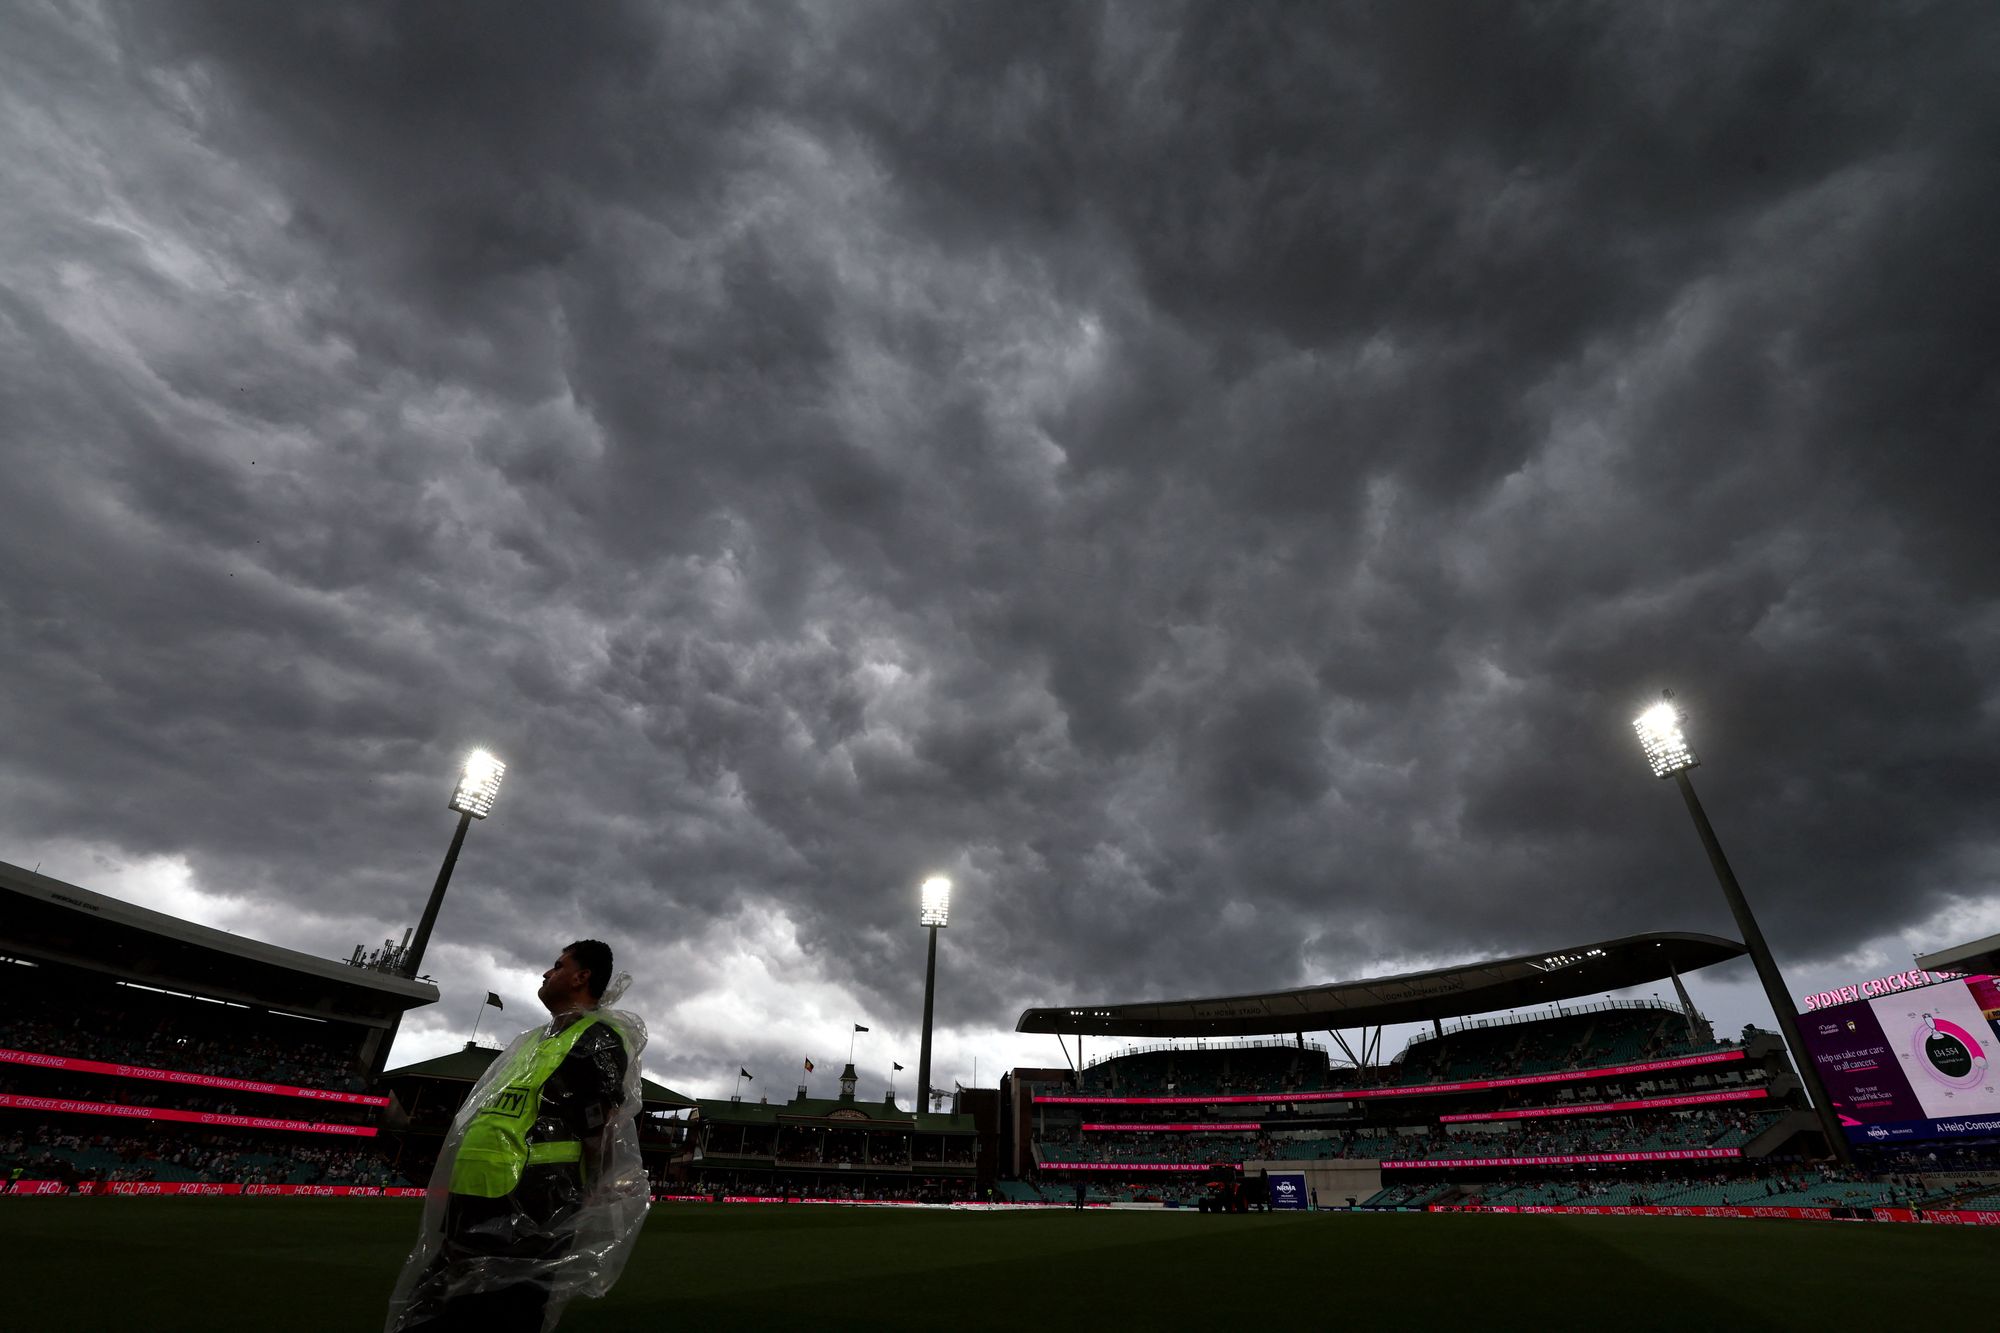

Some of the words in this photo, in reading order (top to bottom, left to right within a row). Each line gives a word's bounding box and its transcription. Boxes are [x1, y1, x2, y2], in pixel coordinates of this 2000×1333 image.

[1804, 984, 1860, 1010] SYDNEY
[1862, 969, 1933, 997] CRICKET
[0, 1051, 16, 1060] HAT
[18, 1053, 25, 1061] A
[26, 1054, 67, 1067] FEELING!
[1817, 1053, 1834, 1063] Help
[1842, 1050, 1856, 1059] take
[1857, 1049, 1868, 1057] our
[1869, 1046, 1885, 1055] care
[1625, 1064, 1646, 1072] TOYOTA
[1681, 1058, 1696, 1066] WHAT
[1702, 1054, 1727, 1063] FEELING!
[1833, 1064, 1842, 1072] to
[1842, 1062, 1850, 1070] all
[1850, 1058, 1878, 1069] cancers.
[133, 1068, 165, 1079] TOYOTA
[170, 1073, 202, 1084] CRICKET.
[203, 1077, 215, 1086] OH
[216, 1078, 237, 1088] WHAT
[244, 1082, 276, 1092] FEELING!
[298, 1089, 316, 1097] ENG
[1651, 1098, 1672, 1106] TOYOTA
[1674, 1096, 1695, 1104] CRICKET.
[1705, 1093, 1721, 1101] WHAT
[1727, 1091, 1750, 1099] FEELING!
[16, 1097, 57, 1109] CRICKET.
[60, 1101, 74, 1110] OH
[76, 1103, 102, 1113] WHAT
[105, 1106, 112, 1114] A
[113, 1106, 152, 1117] FEELING!
[216, 1116, 248, 1125] TOYOTA
[253, 1118, 285, 1128] CRICKET.
[286, 1121, 297, 1129] OH
[299, 1122, 319, 1131] WHAT
[326, 1125, 357, 1134] FEELING!
[1936, 1123, 1944, 1133] A
[1945, 1122, 1965, 1133] Help
[1867, 1129, 1889, 1138] NRMA
[37, 1182, 93, 1194] HCLch
[113, 1183, 161, 1195] HCLTech
[178, 1183, 223, 1195] HCLTech
[240, 1184, 281, 1196] CLTech
[294, 1184, 334, 1196] HCLTech
[1566, 1207, 1600, 1215] HCLTech
[1610, 1207, 1645, 1215] HCLTech
[1657, 1207, 1693, 1216] HCLTech
[1704, 1207, 1740, 1217] HCLTech
[1752, 1207, 1789, 1218] HCLTech
